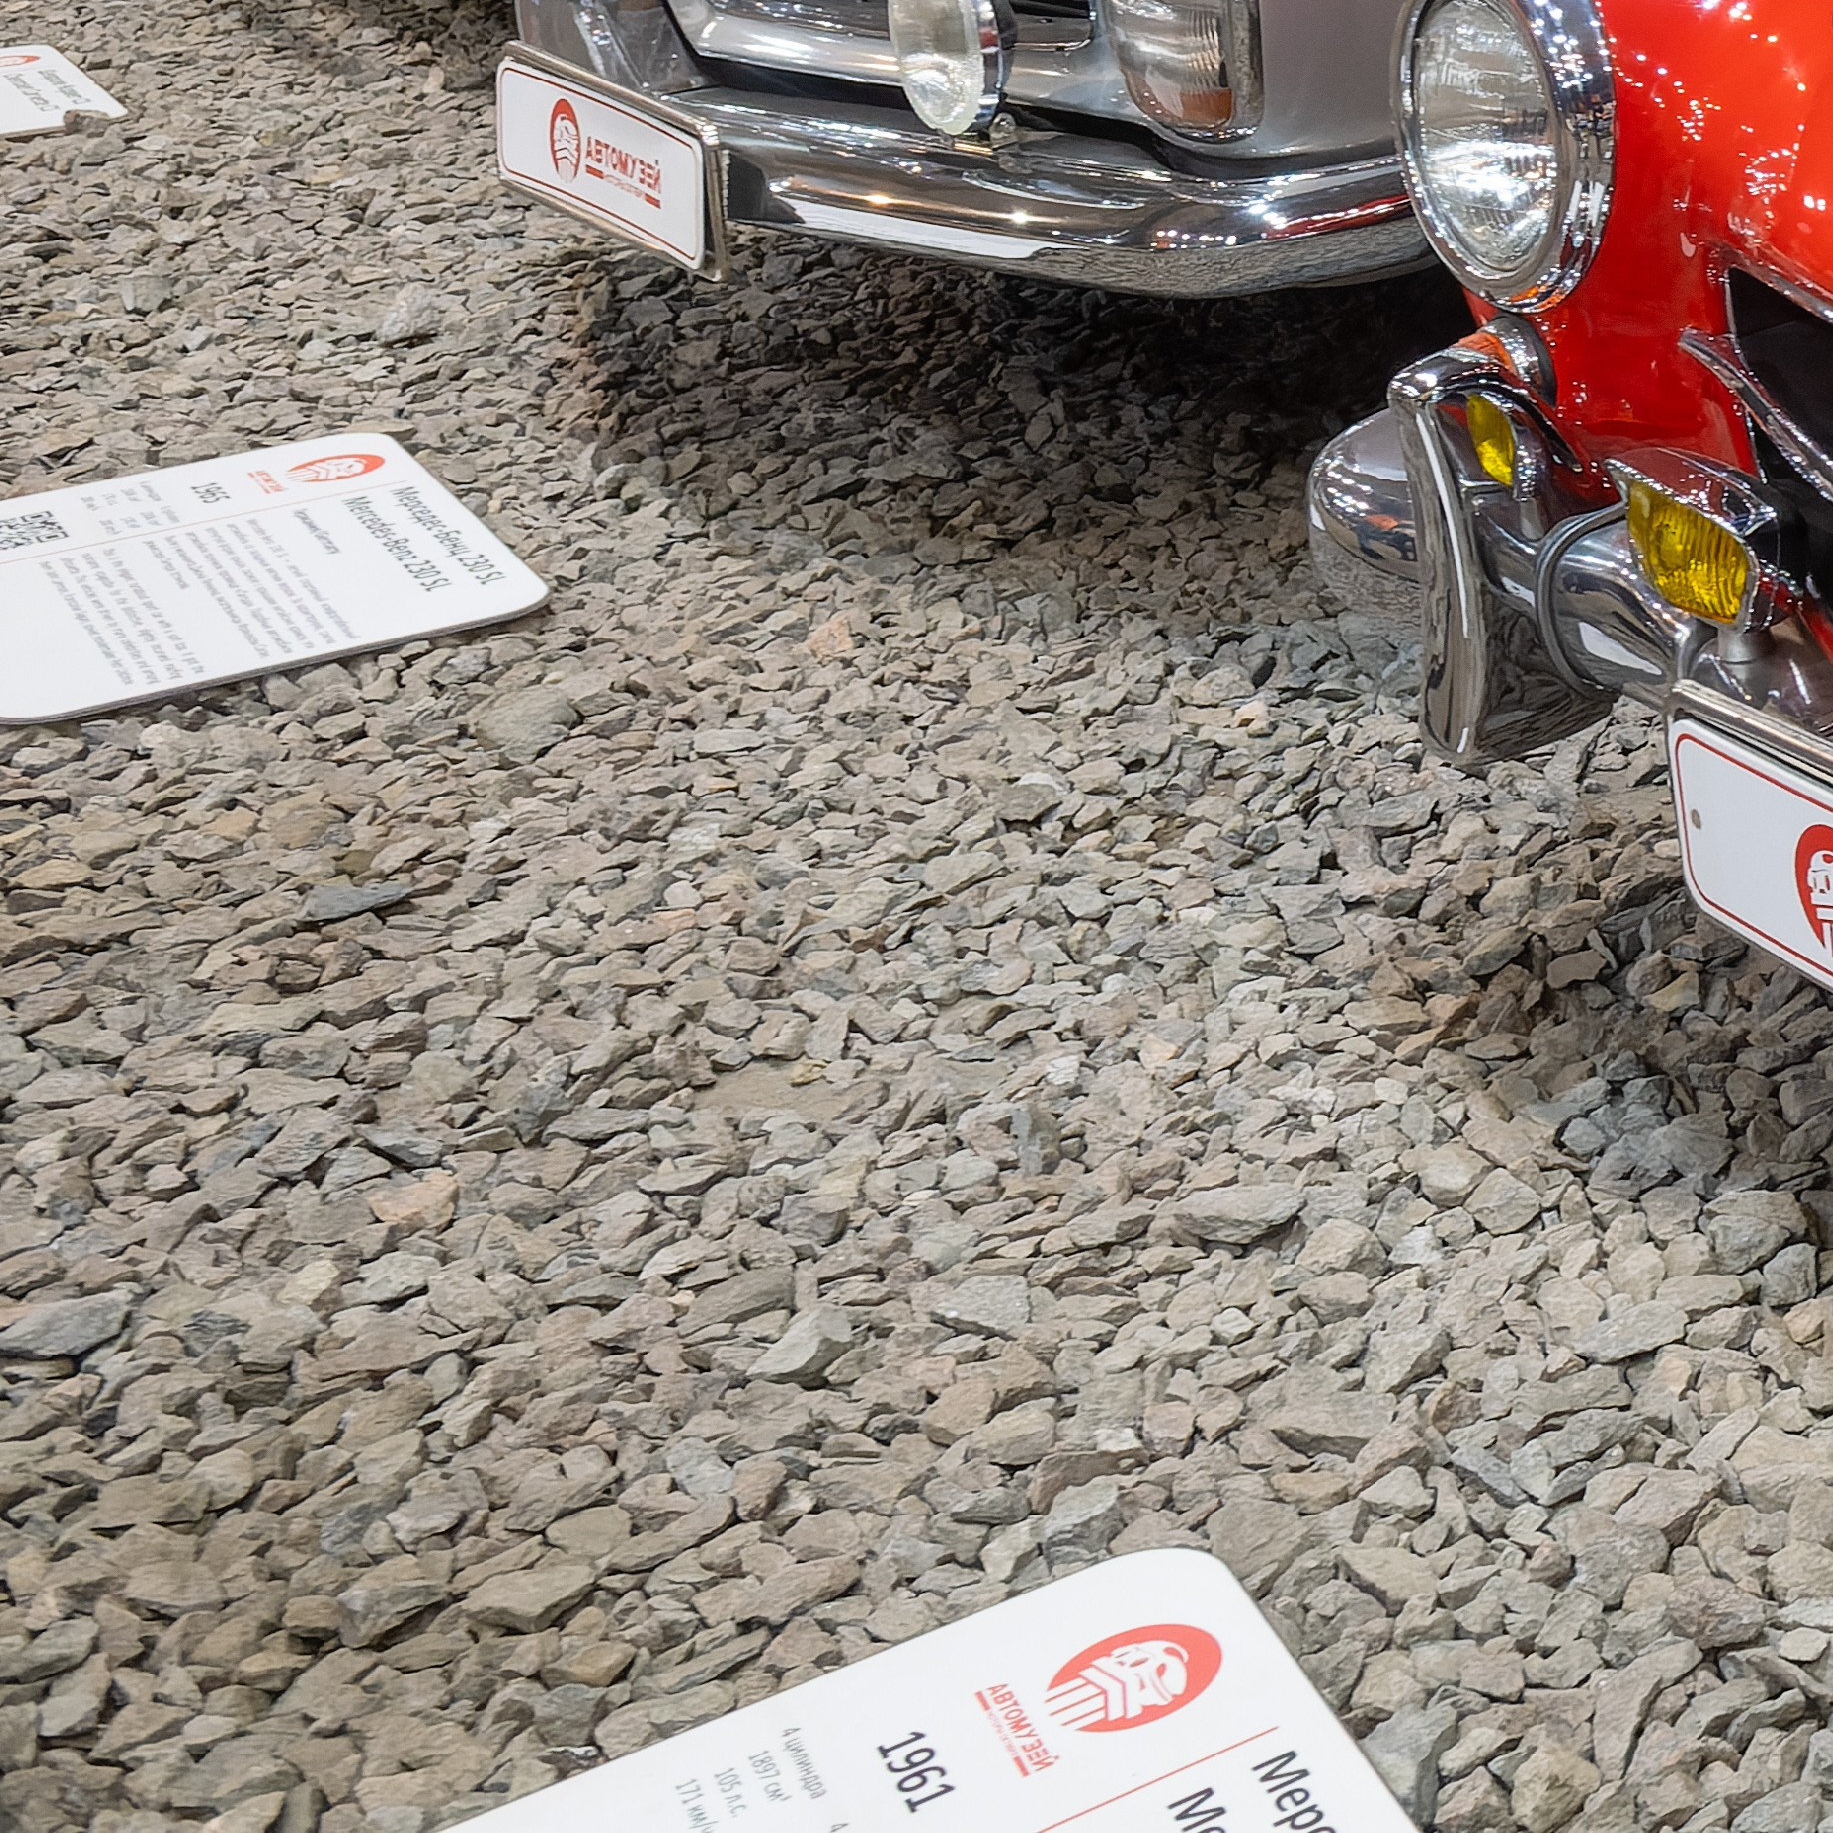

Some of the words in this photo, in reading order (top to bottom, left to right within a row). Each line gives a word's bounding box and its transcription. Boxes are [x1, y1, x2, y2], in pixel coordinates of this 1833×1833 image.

[586, 136, 661, 194] АВТОМУЗЕЙ
[191, 483, 231, 503] 1965
[341, 496, 417, 561] Mercedes-Benz
[404, 560, 441, 579] 230
[390, 486, 470, 557] Мерседес-Бенц
[458, 554, 494, 572] 230
[782, 1727, 801, 1738] 4
[986, 1683, 1059, 1772] АВТОМУЗЕЙ
[676, 1779, 704, 1804] 171
[714, 1767, 742, 1793] 105
[749, 1750, 781, 1780] 1897
[783, 1738, 827, 1799] цилиндра
[878, 1731, 955, 1813] 1961
